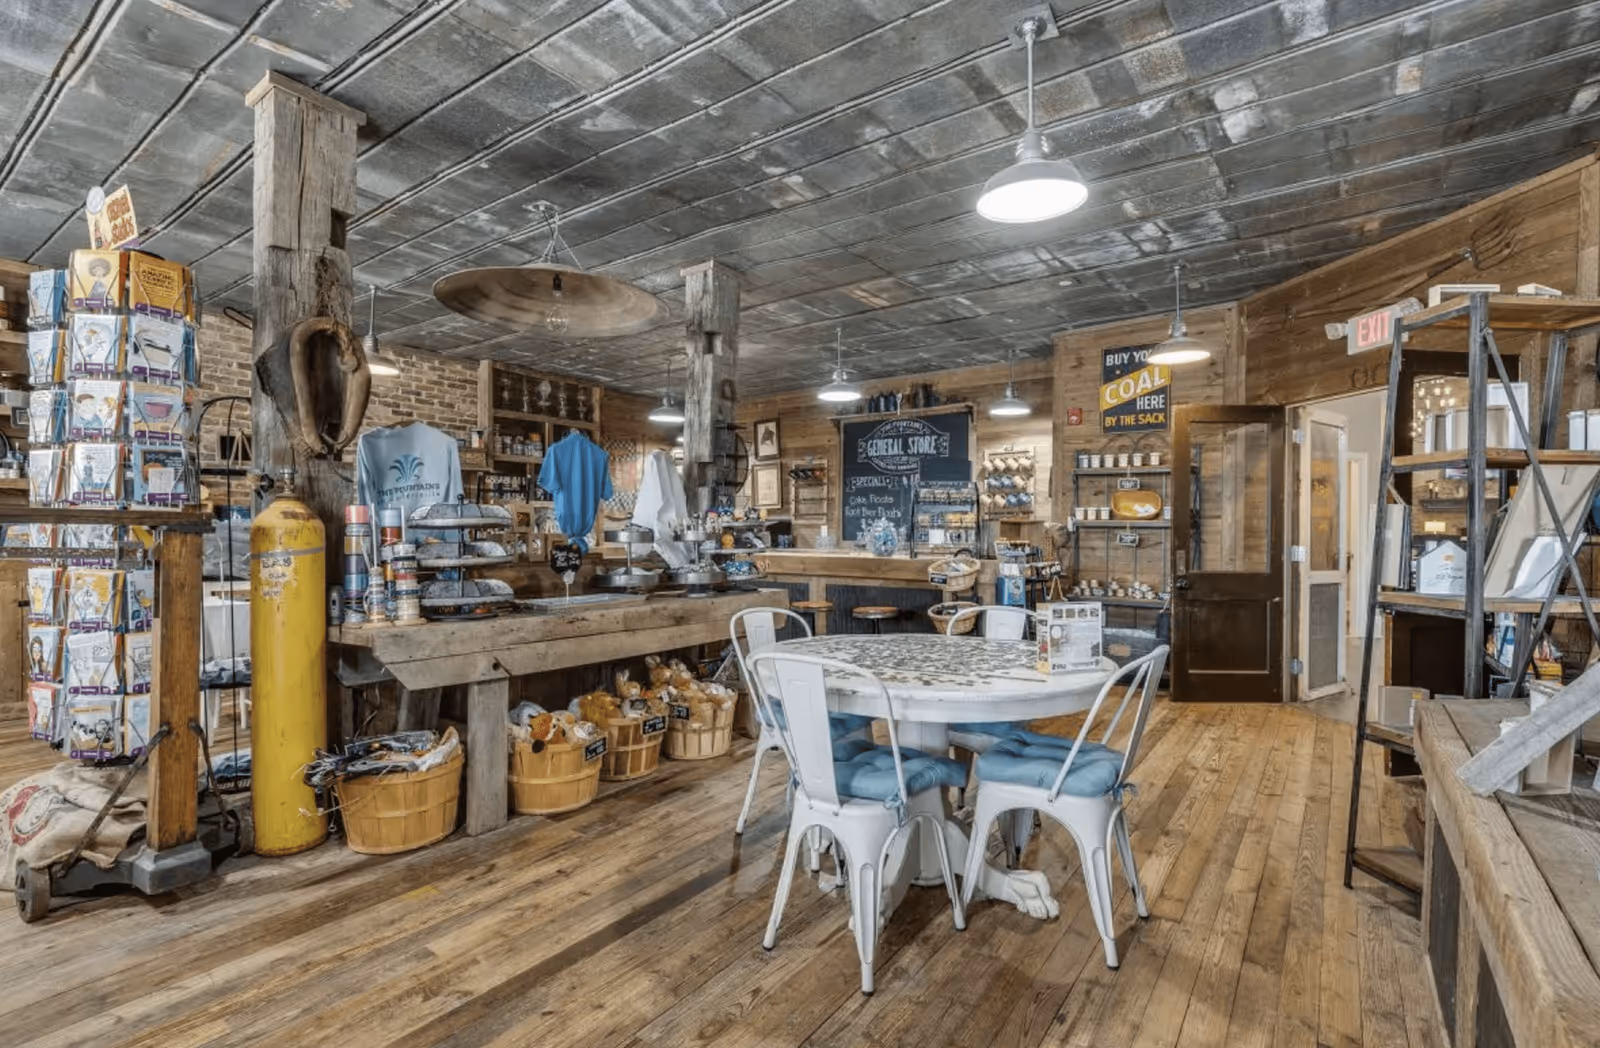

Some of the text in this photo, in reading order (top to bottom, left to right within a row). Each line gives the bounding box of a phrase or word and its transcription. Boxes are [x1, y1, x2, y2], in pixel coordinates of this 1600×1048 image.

[1357, 311, 1392, 347] EXIT
[1106, 352, 1130, 367] BUY
[1105, 366, 1166, 404] COAL
[1136, 394, 1165, 410] HERE
[1105, 413, 1165, 427] BY THE SACK
[867, 435, 937, 456] GENERAL STORE
